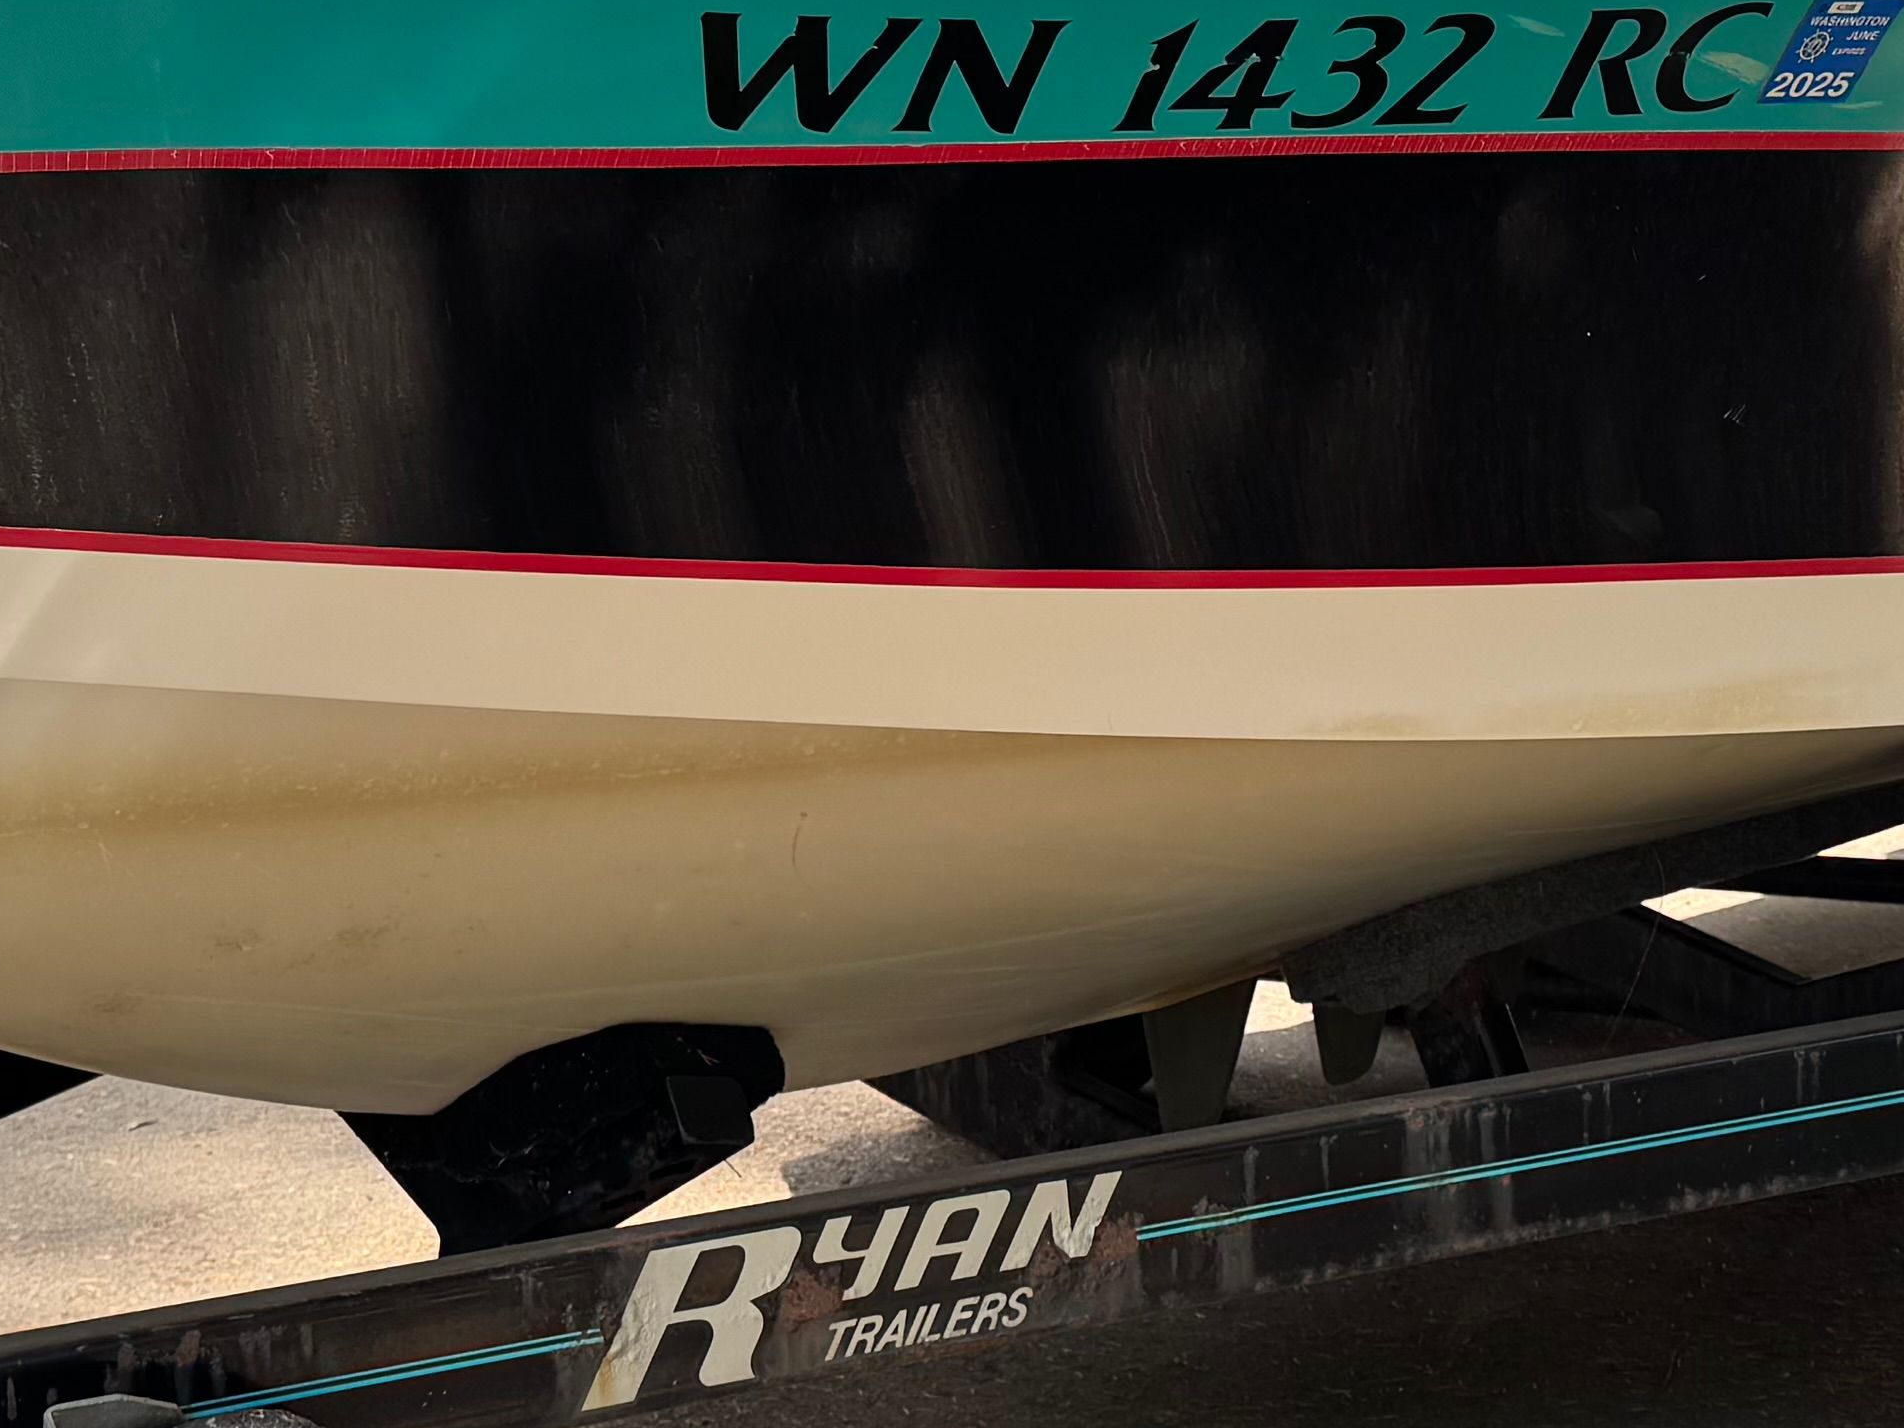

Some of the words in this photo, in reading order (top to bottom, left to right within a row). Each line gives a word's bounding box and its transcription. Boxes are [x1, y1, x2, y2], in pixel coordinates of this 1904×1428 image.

[1810, 16, 1891, 27] WASHINGTON
[1846, 30, 1880, 41] JUNE
[701, 12, 1073, 135] WN
[1112, 13, 1496, 132] 1432
[1536, 2, 1774, 120] RC
[1765, 72, 1856, 98] 2025
[581, 1170, 1123, 1413] RYAN
[824, 1286, 1034, 1362] TRAILERS
